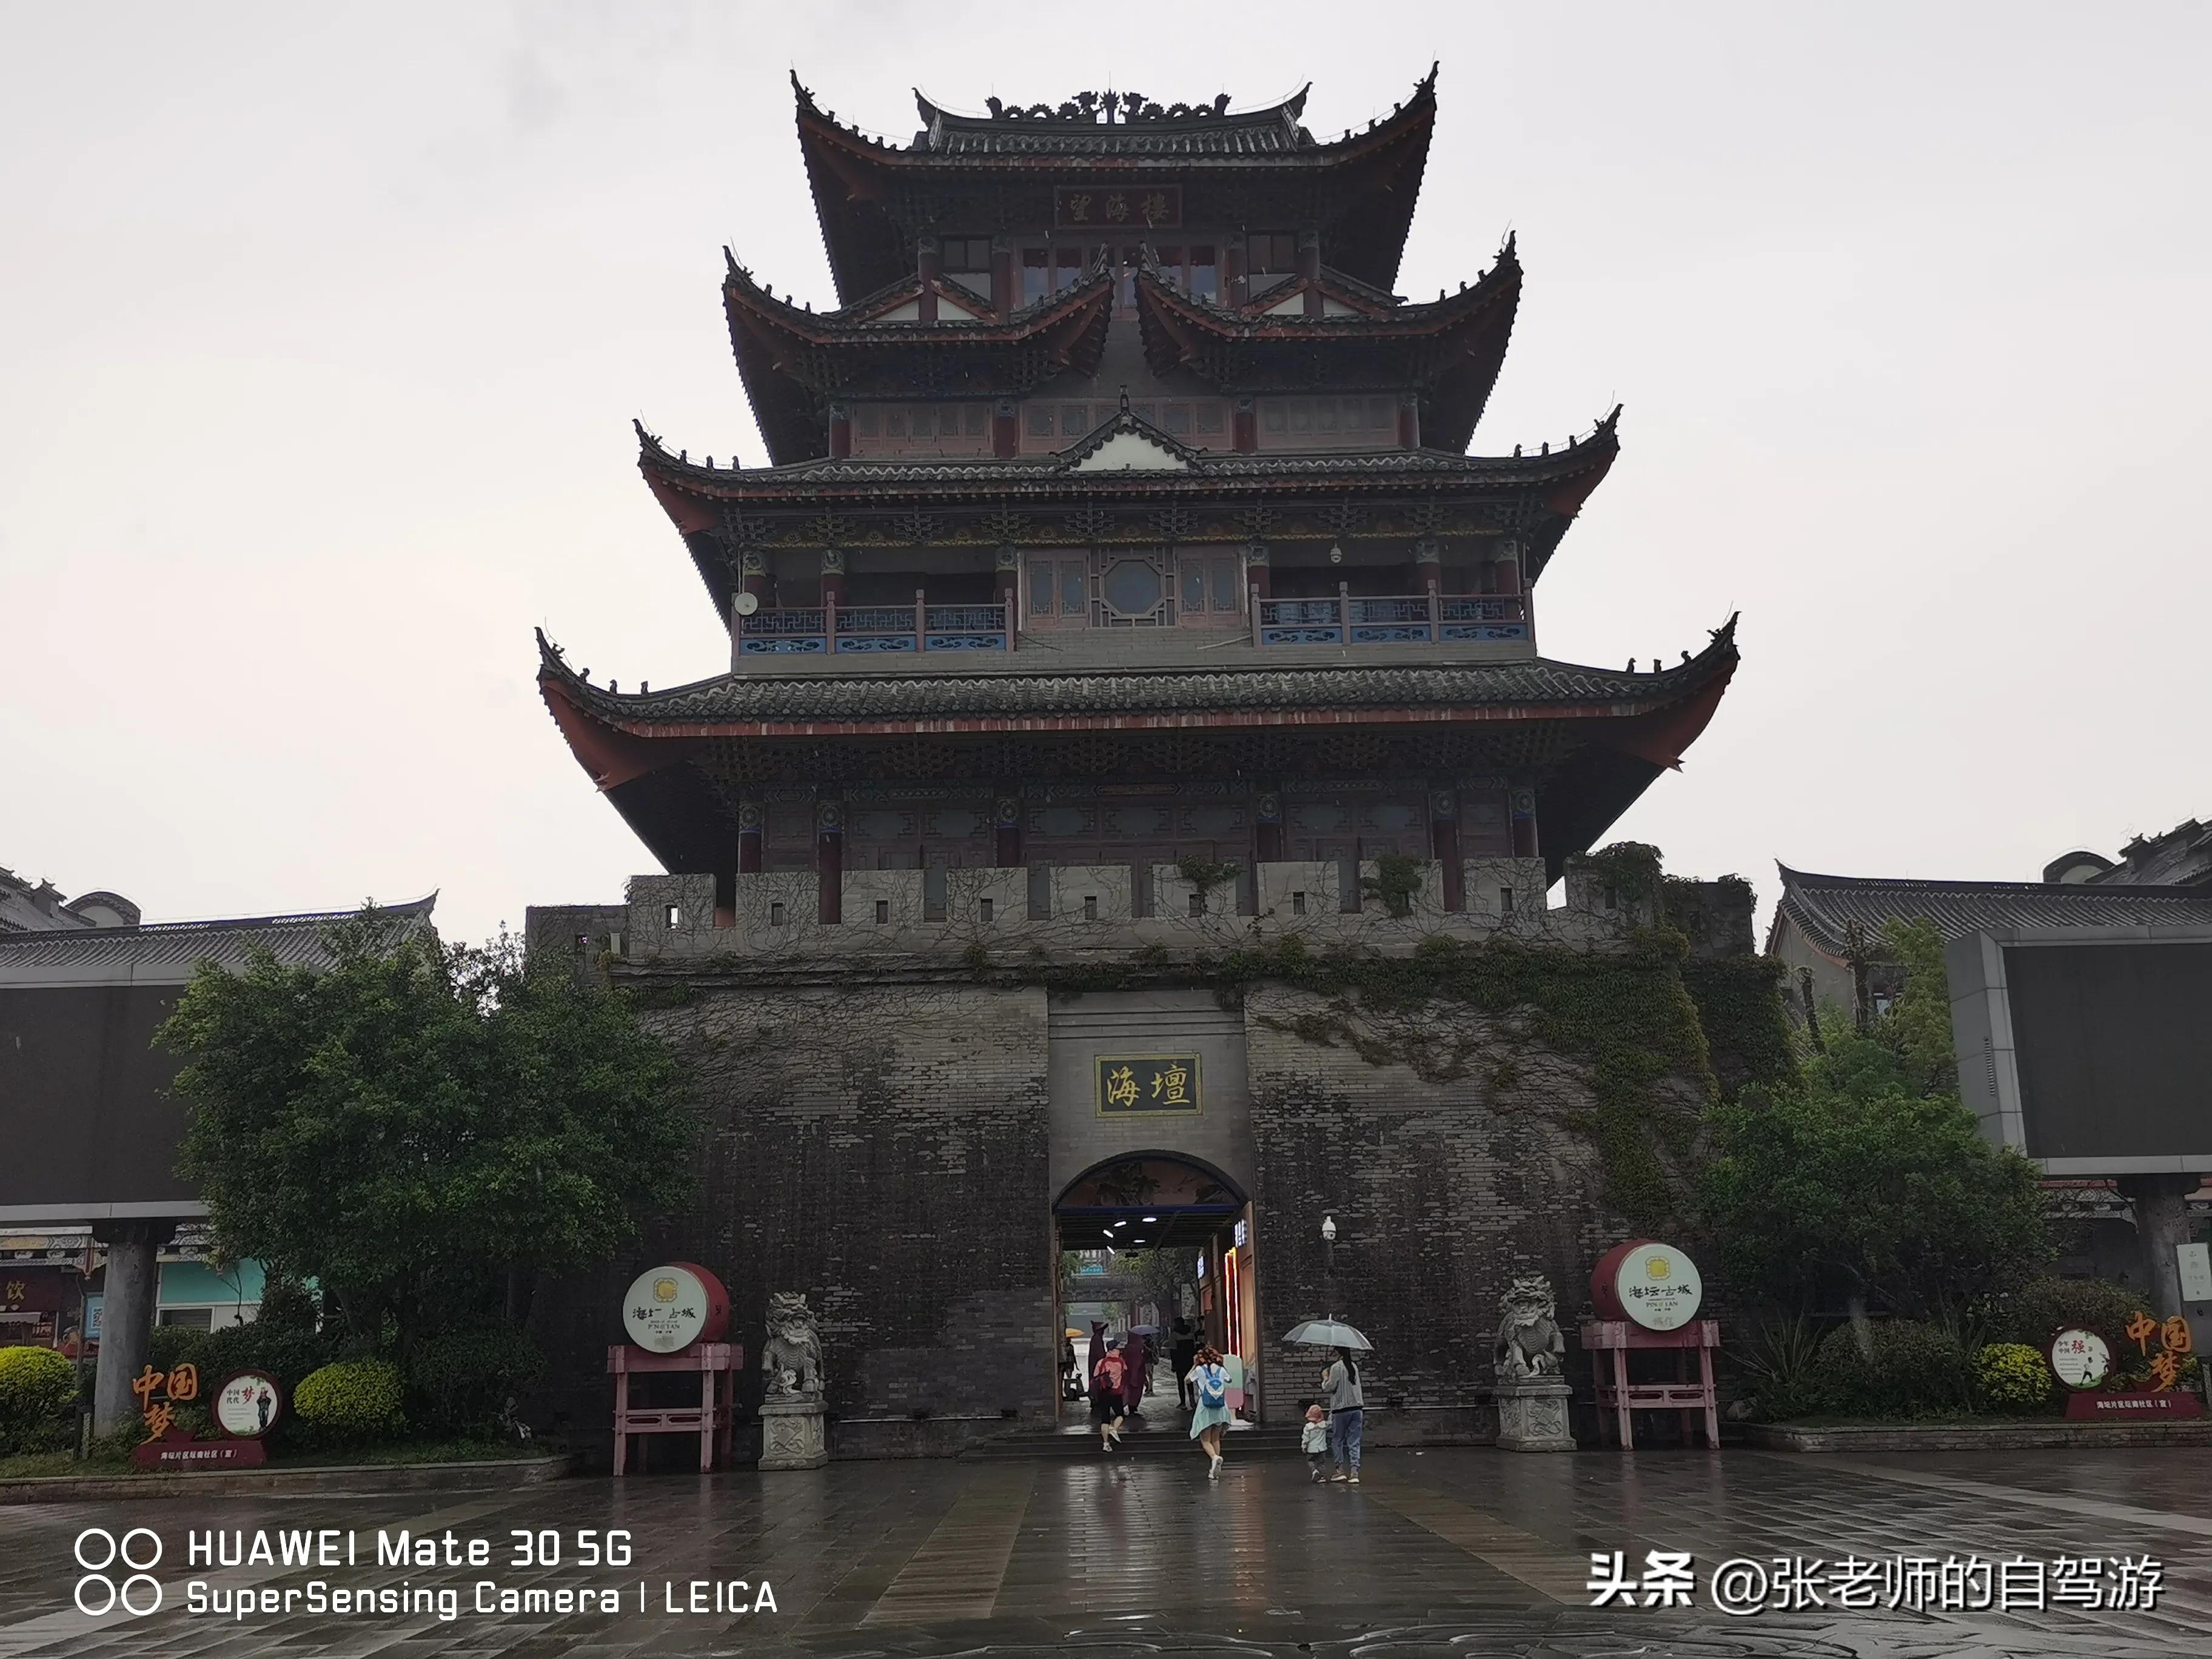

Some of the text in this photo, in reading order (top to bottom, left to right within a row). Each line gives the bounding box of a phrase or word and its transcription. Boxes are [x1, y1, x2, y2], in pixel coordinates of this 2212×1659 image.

[1107, 1063, 1191, 1107] 海壇
[1629, 1284, 1693, 1299] 海坛古城
[2124, 1310, 2192, 1358] 中国
[132, 1362, 198, 1411] 中国
[2148, 1350, 2181, 1393] 梦
[139, 1401, 176, 1446] 梦
